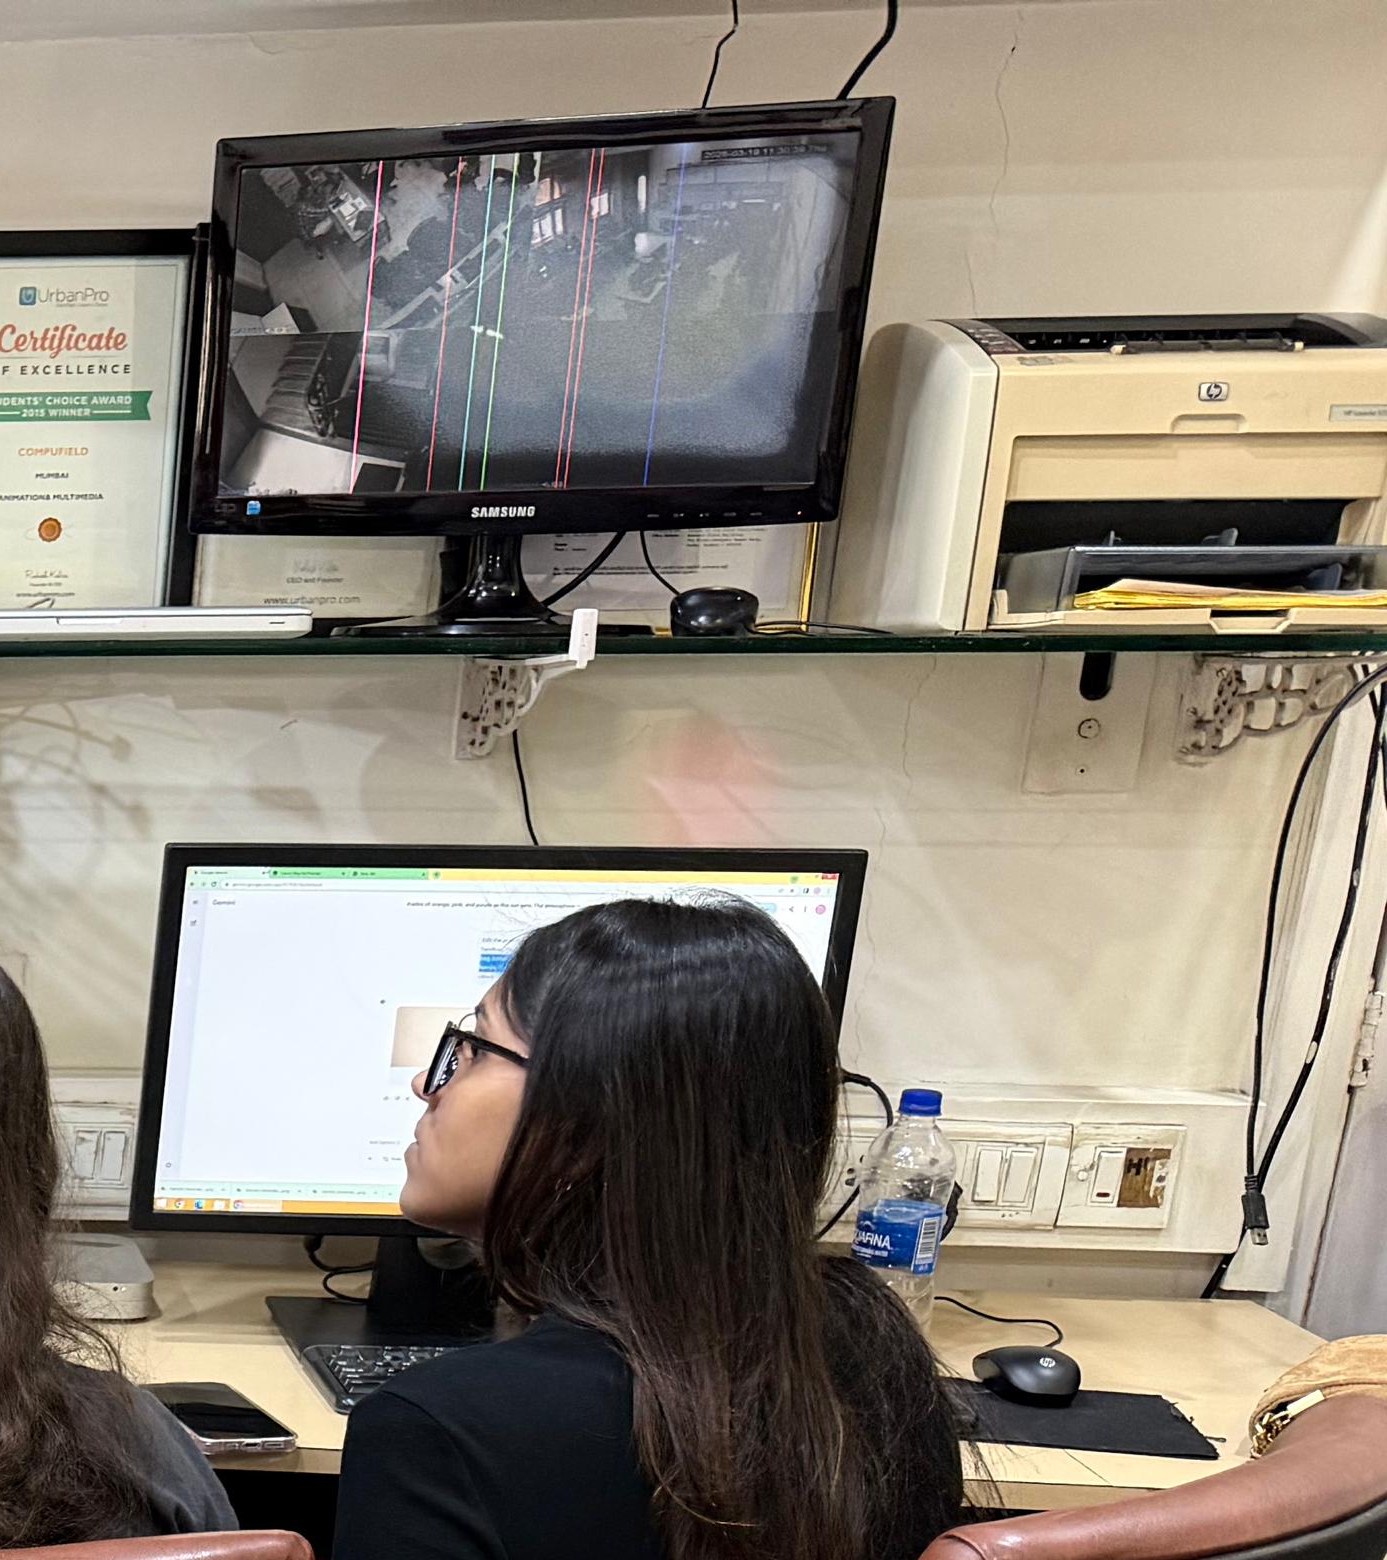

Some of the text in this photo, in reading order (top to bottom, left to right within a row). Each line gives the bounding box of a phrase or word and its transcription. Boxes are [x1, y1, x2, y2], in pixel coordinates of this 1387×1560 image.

[38, 288, 110, 304] UrbanPro
[20, 364, 132, 376] EXCELLENCE
[45, 396, 87, 405] CHOICE
[91, 395, 132, 405] AWARD
[48, 408, 91, 417] WINNER
[18, 447, 89, 457] COMPUFIELD
[471, 505, 535, 519] SAMSUNG
